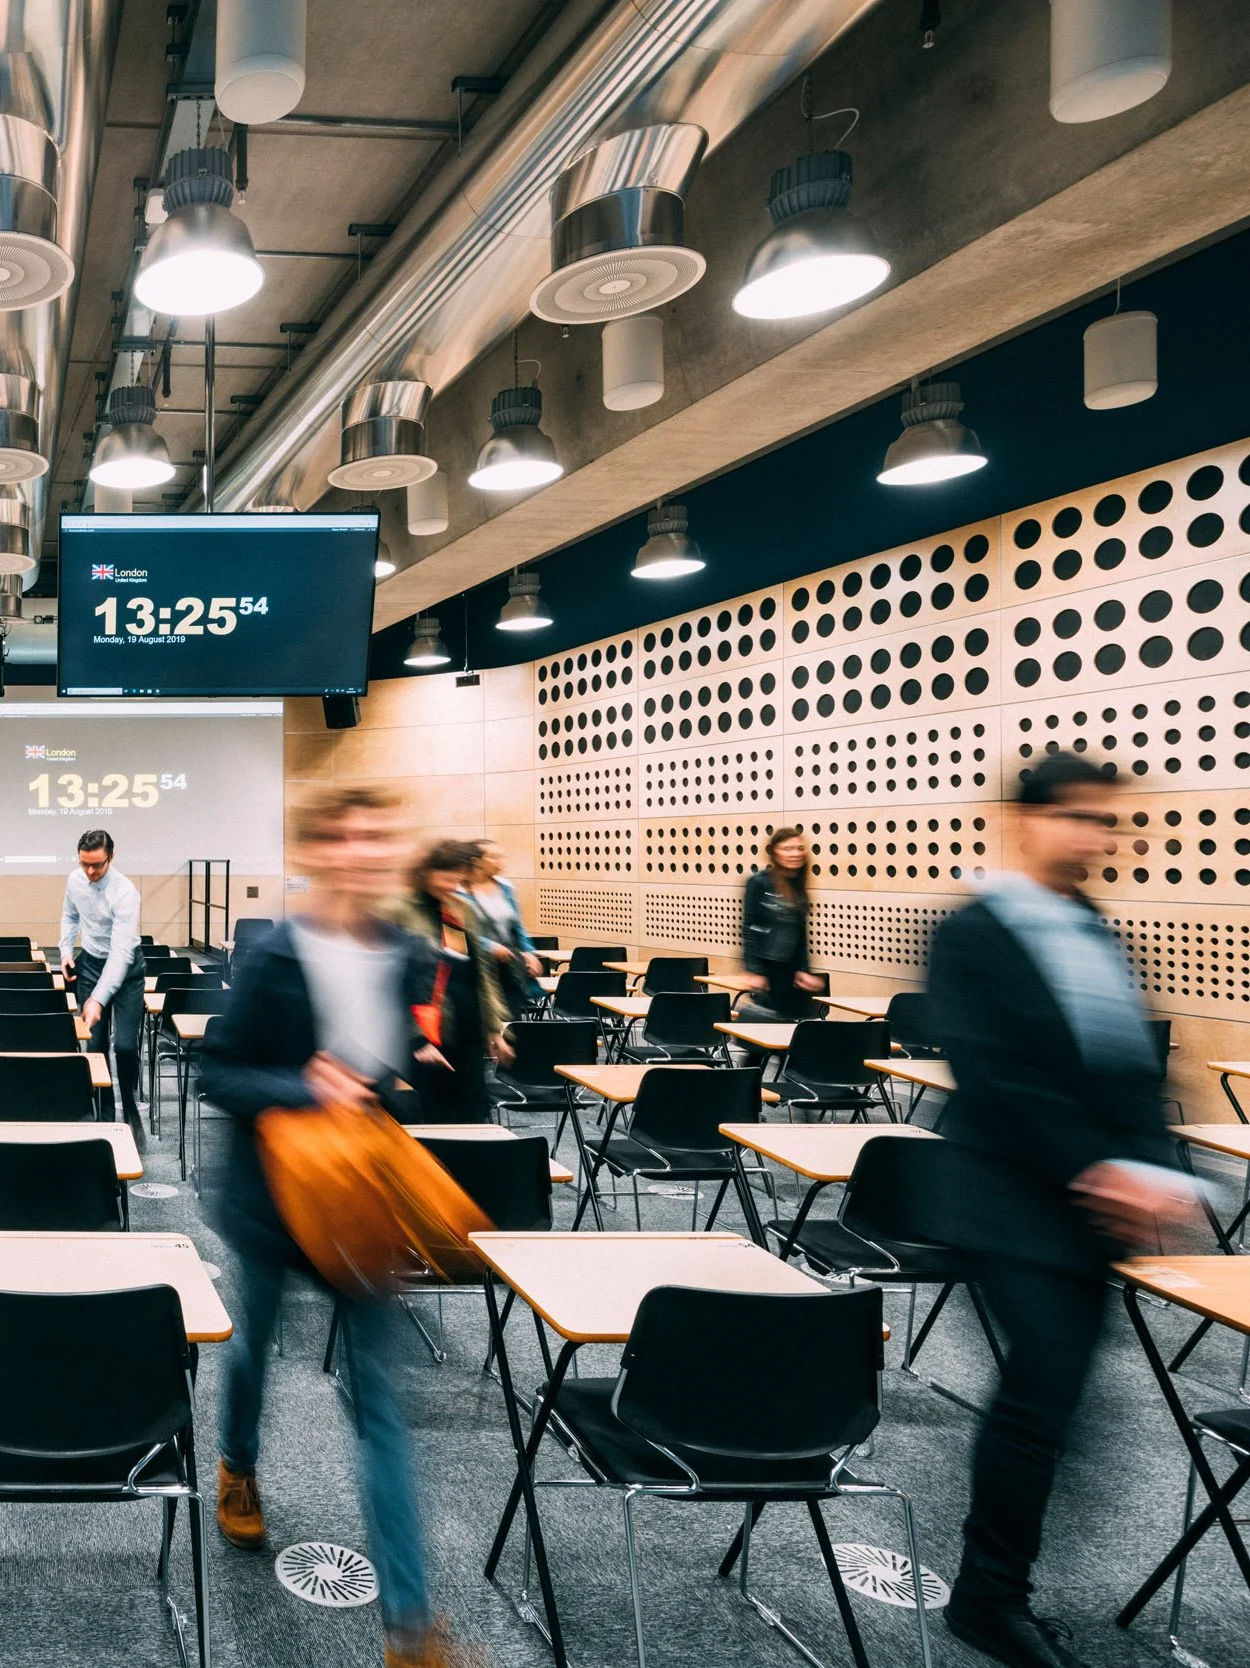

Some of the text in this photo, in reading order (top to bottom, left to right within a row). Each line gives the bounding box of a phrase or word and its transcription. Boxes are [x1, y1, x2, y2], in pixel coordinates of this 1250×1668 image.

[115, 568, 148, 577] London
[94, 596, 269, 636] 13:25 54
[93, 635, 186, 645] Monday, 19 August 2019
[46, 748, 76, 756] London
[28, 773, 188, 808] 13:25 54
[28, 808, 58, 817] Monday,
[69, 808, 94, 817] August
